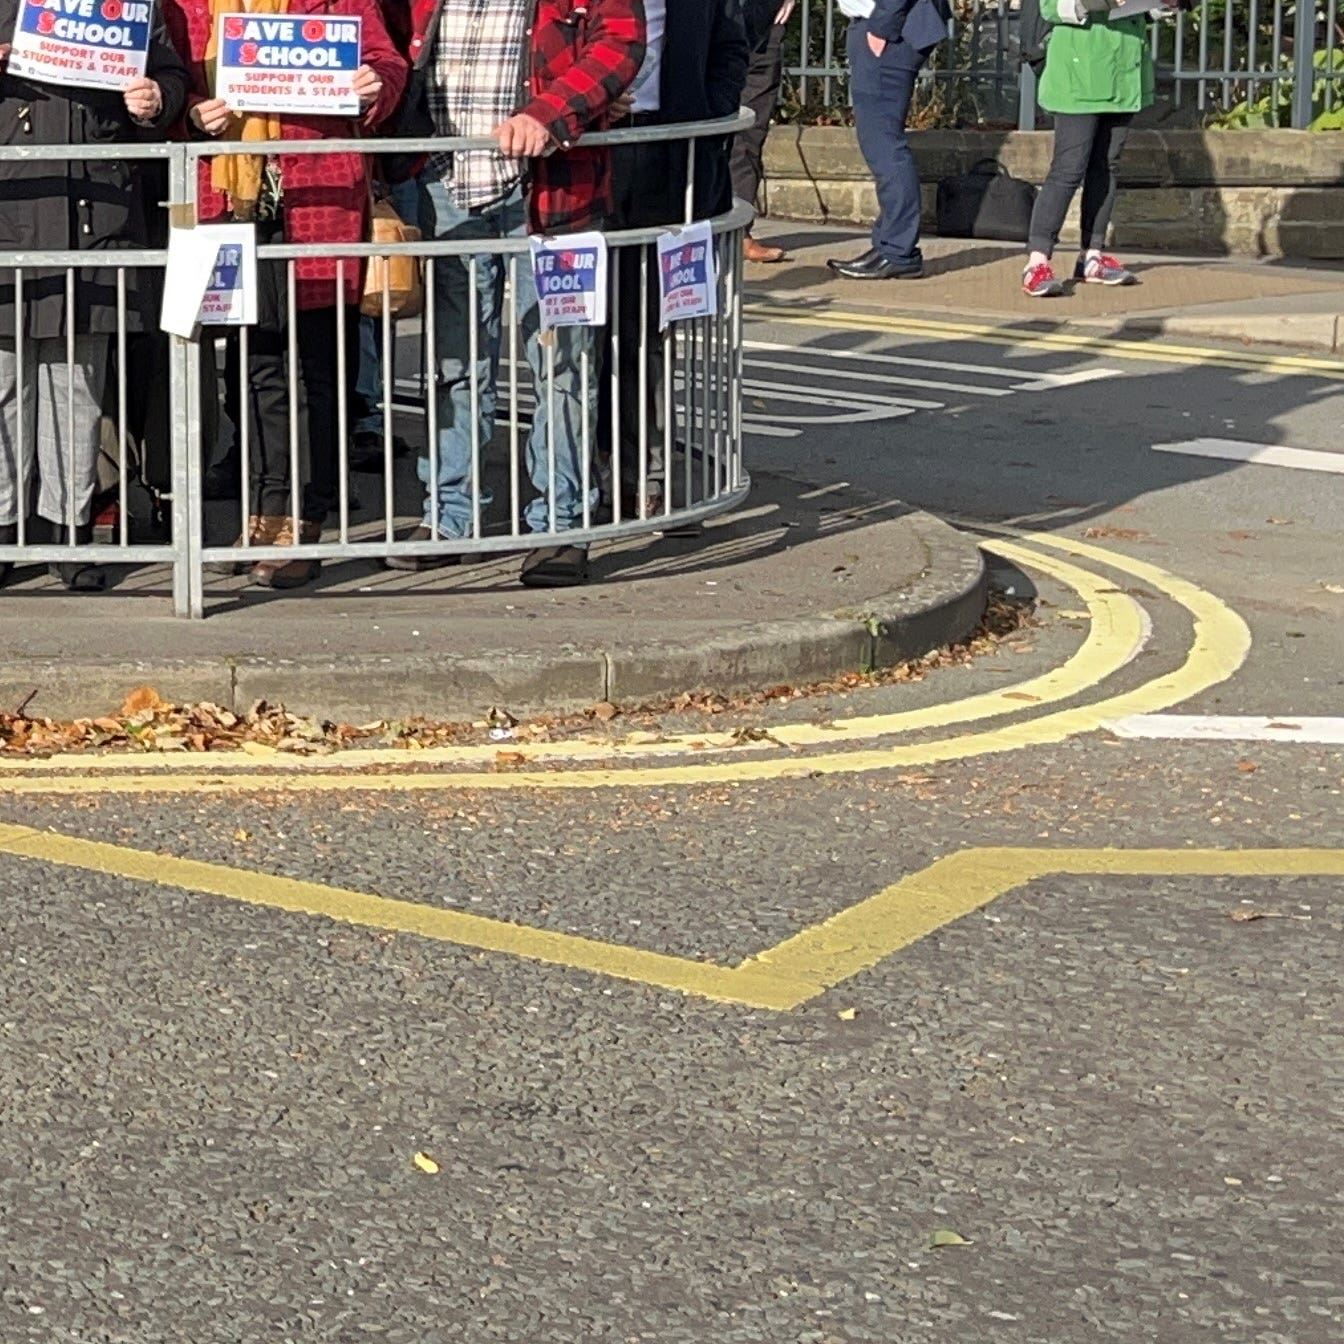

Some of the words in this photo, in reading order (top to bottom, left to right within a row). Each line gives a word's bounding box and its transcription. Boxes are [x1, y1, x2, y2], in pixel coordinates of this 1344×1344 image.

[37, 12, 133, 46] SCHOOL
[226, 19, 294, 41] SAVE
[302, 21, 357, 43] OUR
[239, 43, 342, 67] SCHOOL
